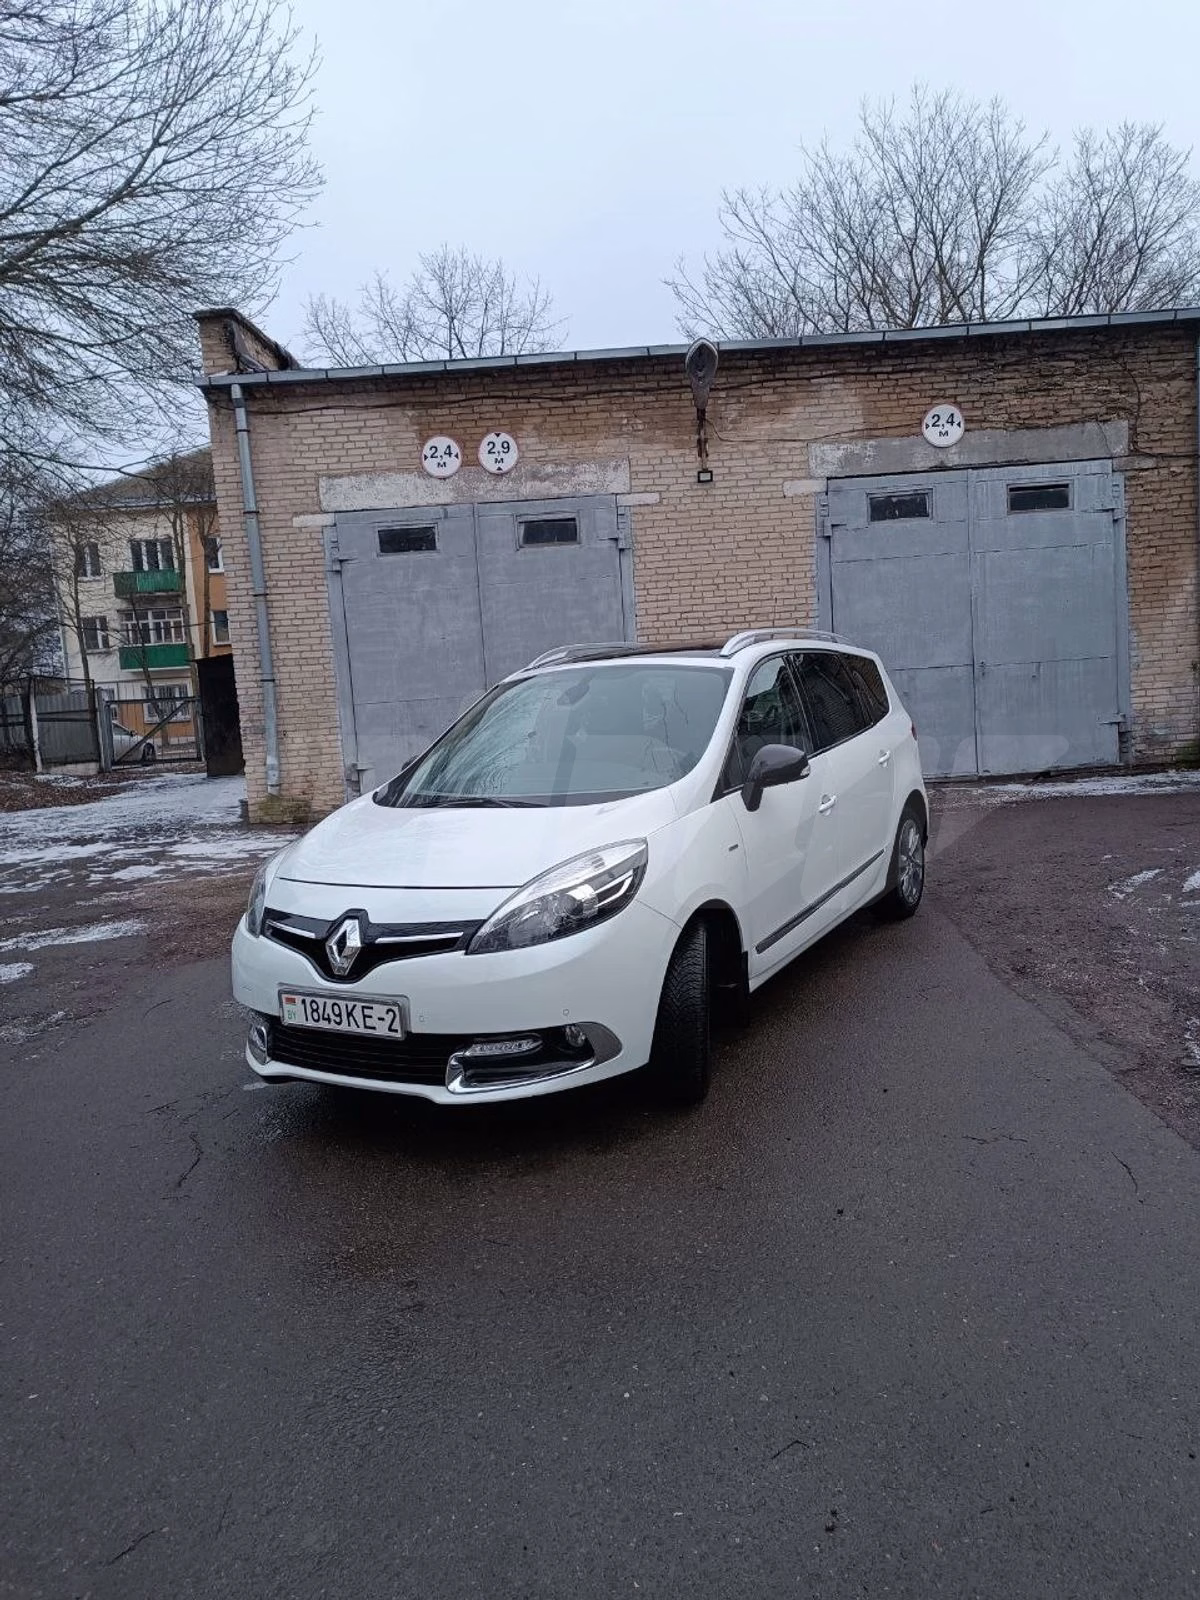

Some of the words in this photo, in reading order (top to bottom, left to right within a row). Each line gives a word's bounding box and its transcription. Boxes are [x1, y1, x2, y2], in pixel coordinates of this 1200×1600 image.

[931, 413, 955, 430] 2,4
[429, 444, 453, 461] 2,4
[487, 441, 510, 457] 2,9
